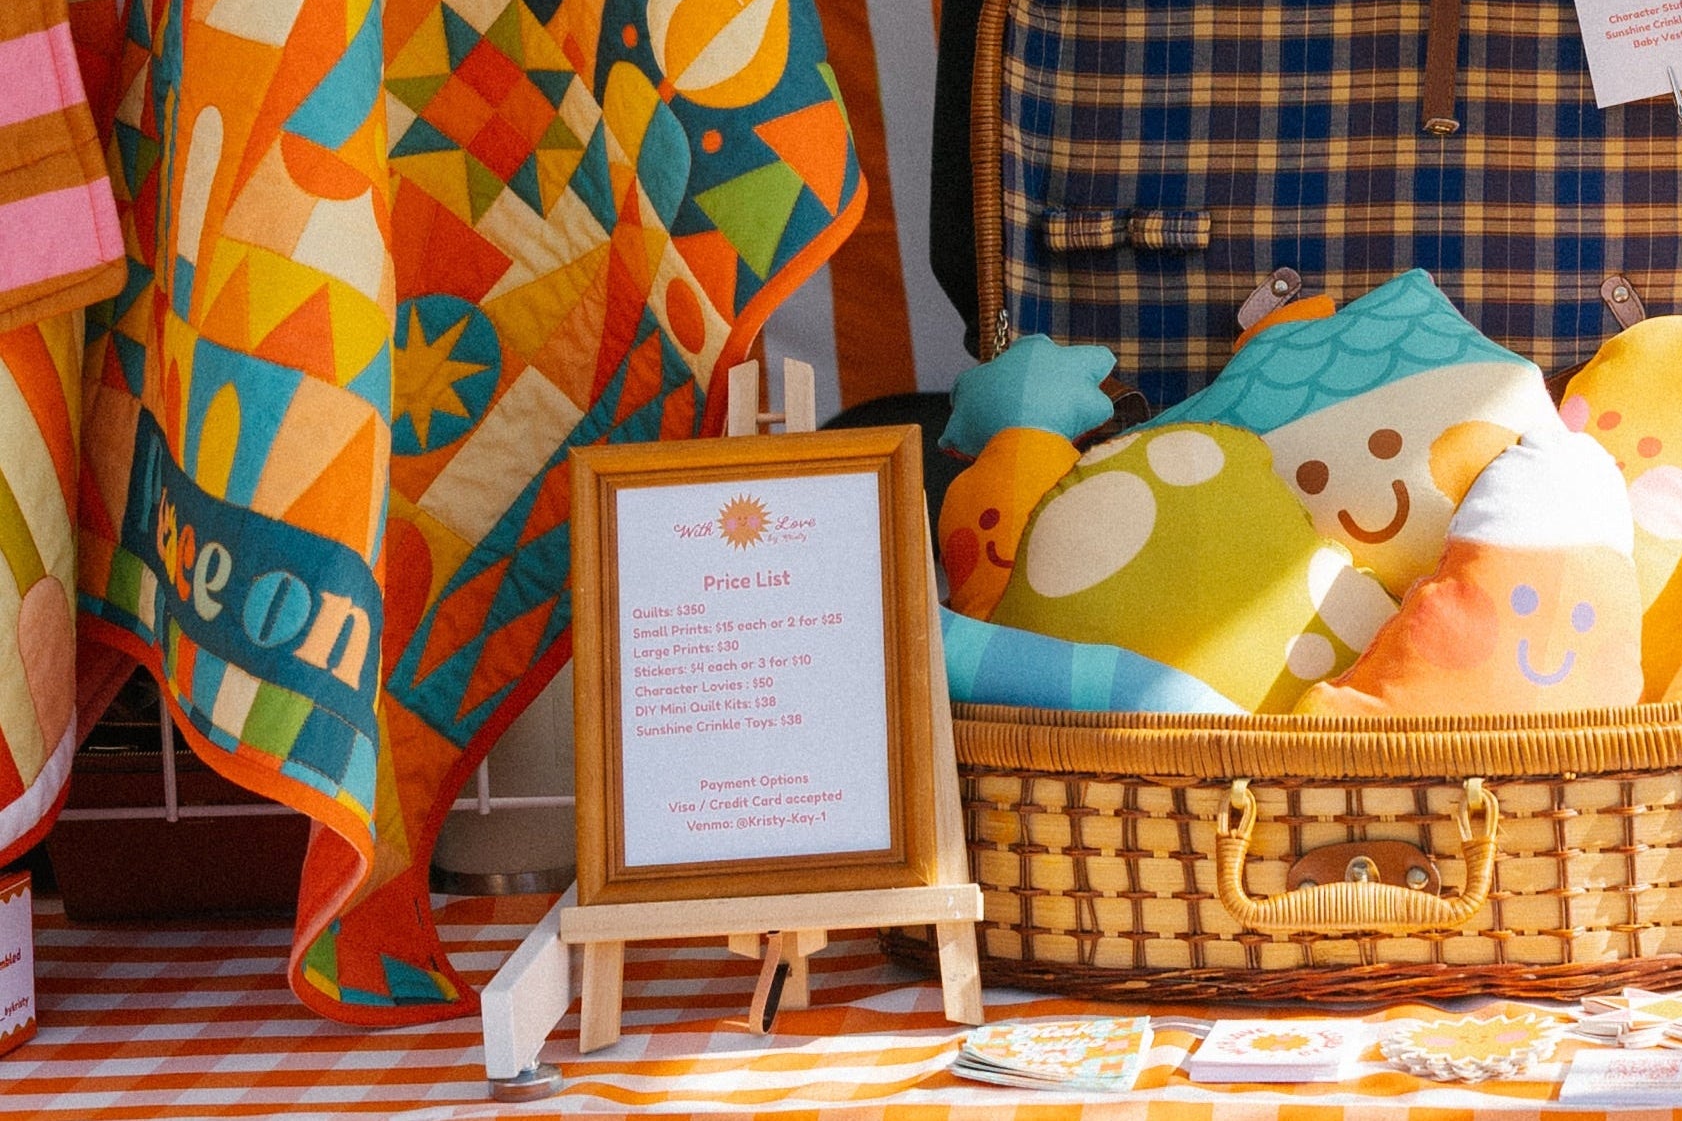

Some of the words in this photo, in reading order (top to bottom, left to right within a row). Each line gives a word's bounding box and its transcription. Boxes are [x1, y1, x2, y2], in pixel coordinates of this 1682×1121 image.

[1609, 6, 1660, 24] Character
[1605, 23, 1651, 40] Sunshine
[1633, 34, 1659, 49] Baby
[674, 520, 714, 539] With
[775, 516, 816, 530] Love
[703, 573, 751, 592] Price
[756, 570, 790, 587] List
[632, 607, 673, 619] Quilts:
[676, 603, 705, 616] $350
[242, 570, 371, 690] on
[633, 626, 668, 639] Small
[671, 622, 712, 636] Prints:
[715, 620, 733, 633] $15
[737, 618, 767, 631] each
[771, 619, 783, 629] or
[787, 615, 796, 628] 2
[799, 614, 818, 626] for
[821, 612, 842, 625] $25
[633, 645, 670, 660] Large
[673, 643, 714, 656] Prints:
[717, 639, 739, 653] $30
[634, 664, 687, 678] Stickers:
[690, 662, 704, 675] $4
[708, 658, 737, 672] each
[741, 659, 754, 670] or
[757, 657, 766, 669] 3
[769, 655, 789, 668] for
[792, 653, 811, 666] $10
[635, 682, 698, 698] Character
[752, 677, 773, 690] $50
[635, 704, 656, 717] DIY
[660, 701, 687, 714] Mini
[690, 699, 720, 713] Quilt
[724, 698, 752, 711] Kits:
[755, 696, 776, 709] $38
[636, 722, 693, 737] Sunshine
[696, 718, 741, 732] Crinkle
[744, 716, 777, 730] Toys:
[780, 713, 802, 727] $38
[700, 777, 756, 792] Payment
[760, 773, 808, 788] Options
[669, 799, 696, 813] Visa
[699, 798, 706, 812] /
[709, 795, 749, 810] Credit
[753, 793, 782, 807] Card
[785, 790, 842, 806] accepted
[687, 818, 734, 832] Venmo:
